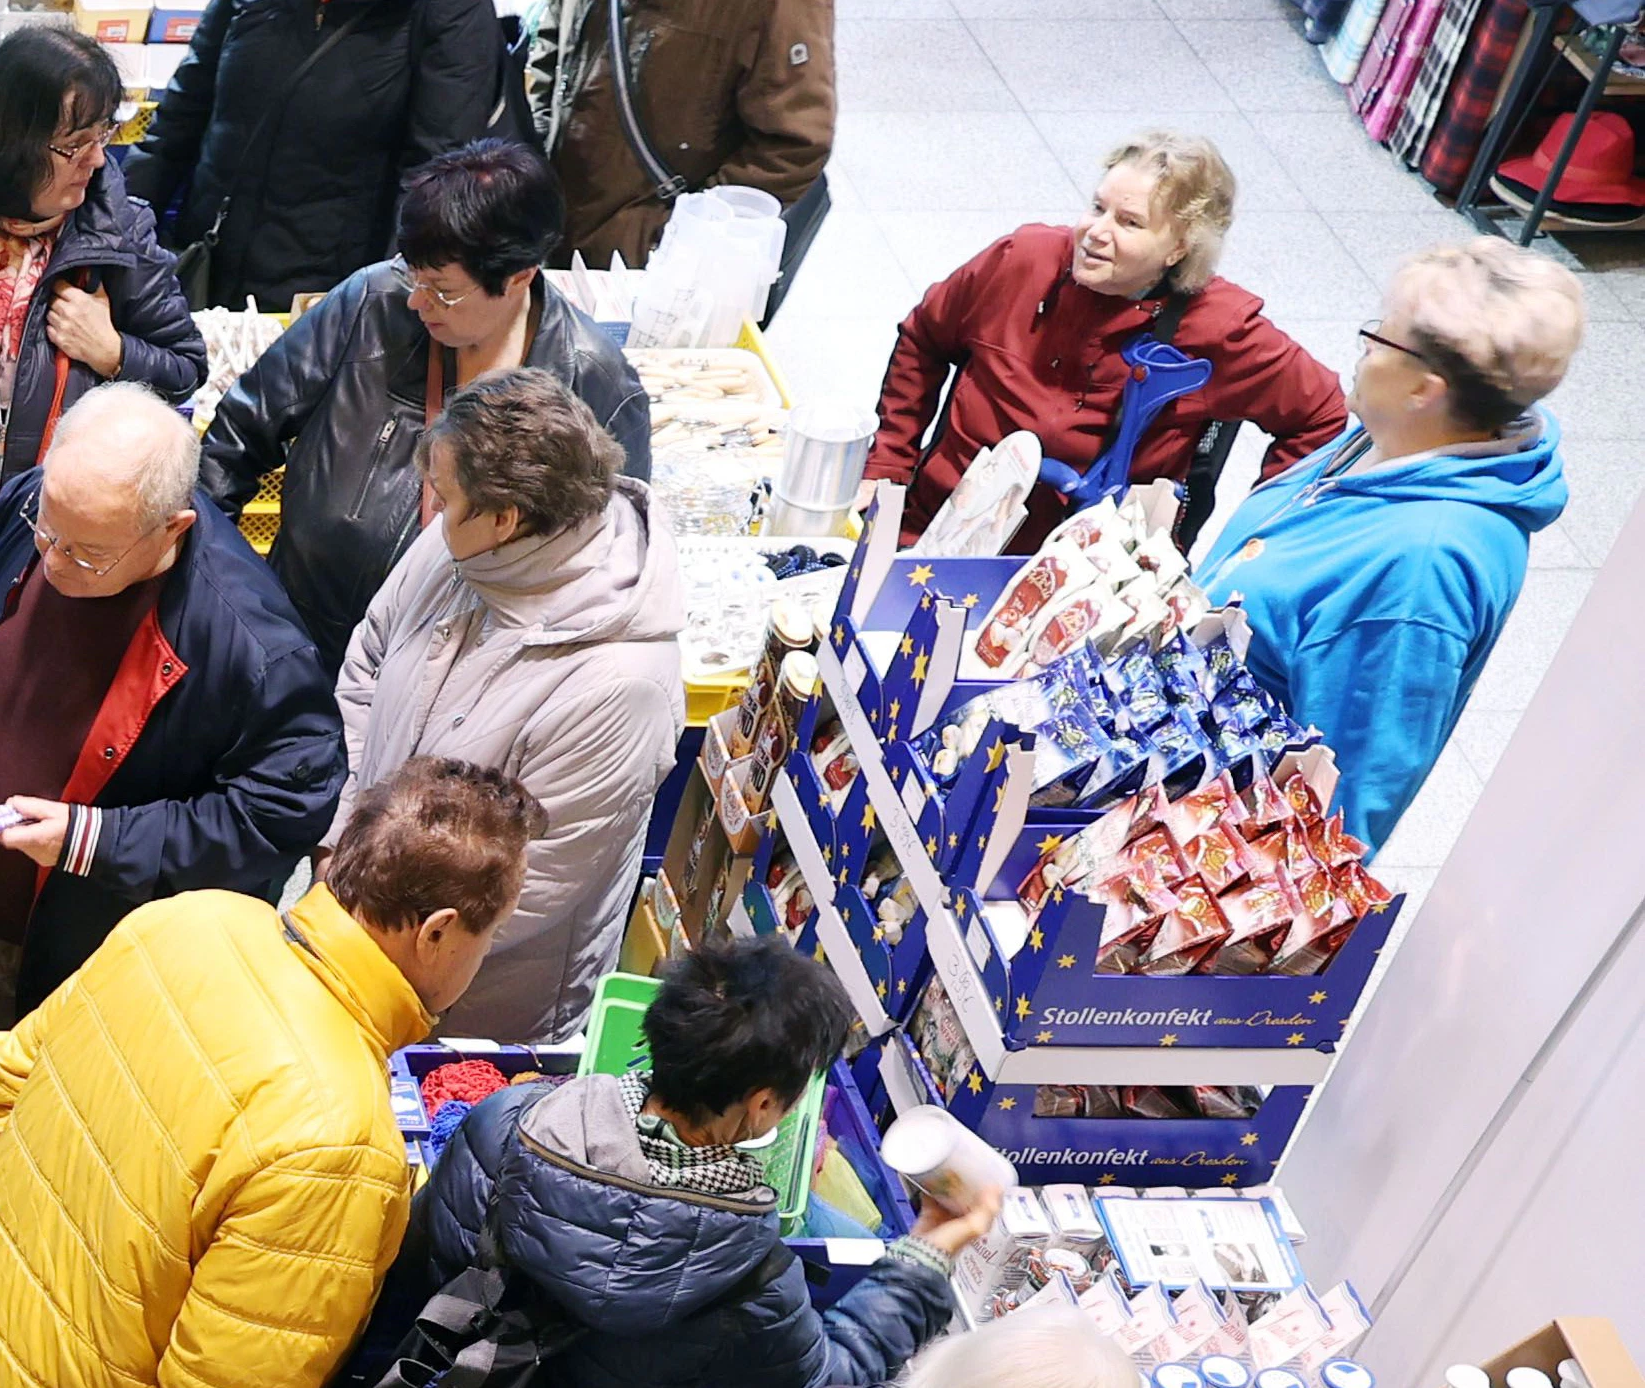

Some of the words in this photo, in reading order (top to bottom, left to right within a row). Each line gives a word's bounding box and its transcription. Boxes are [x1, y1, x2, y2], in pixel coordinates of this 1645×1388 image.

[1039, 1006, 1212, 1027] Stollenkonfekt
[1214, 1015, 1244, 1027] aus
[1244, 1009, 1317, 1028] Dresden
[1149, 1156, 1179, 1166] aus
[1179, 1150, 1249, 1167] Dresden
